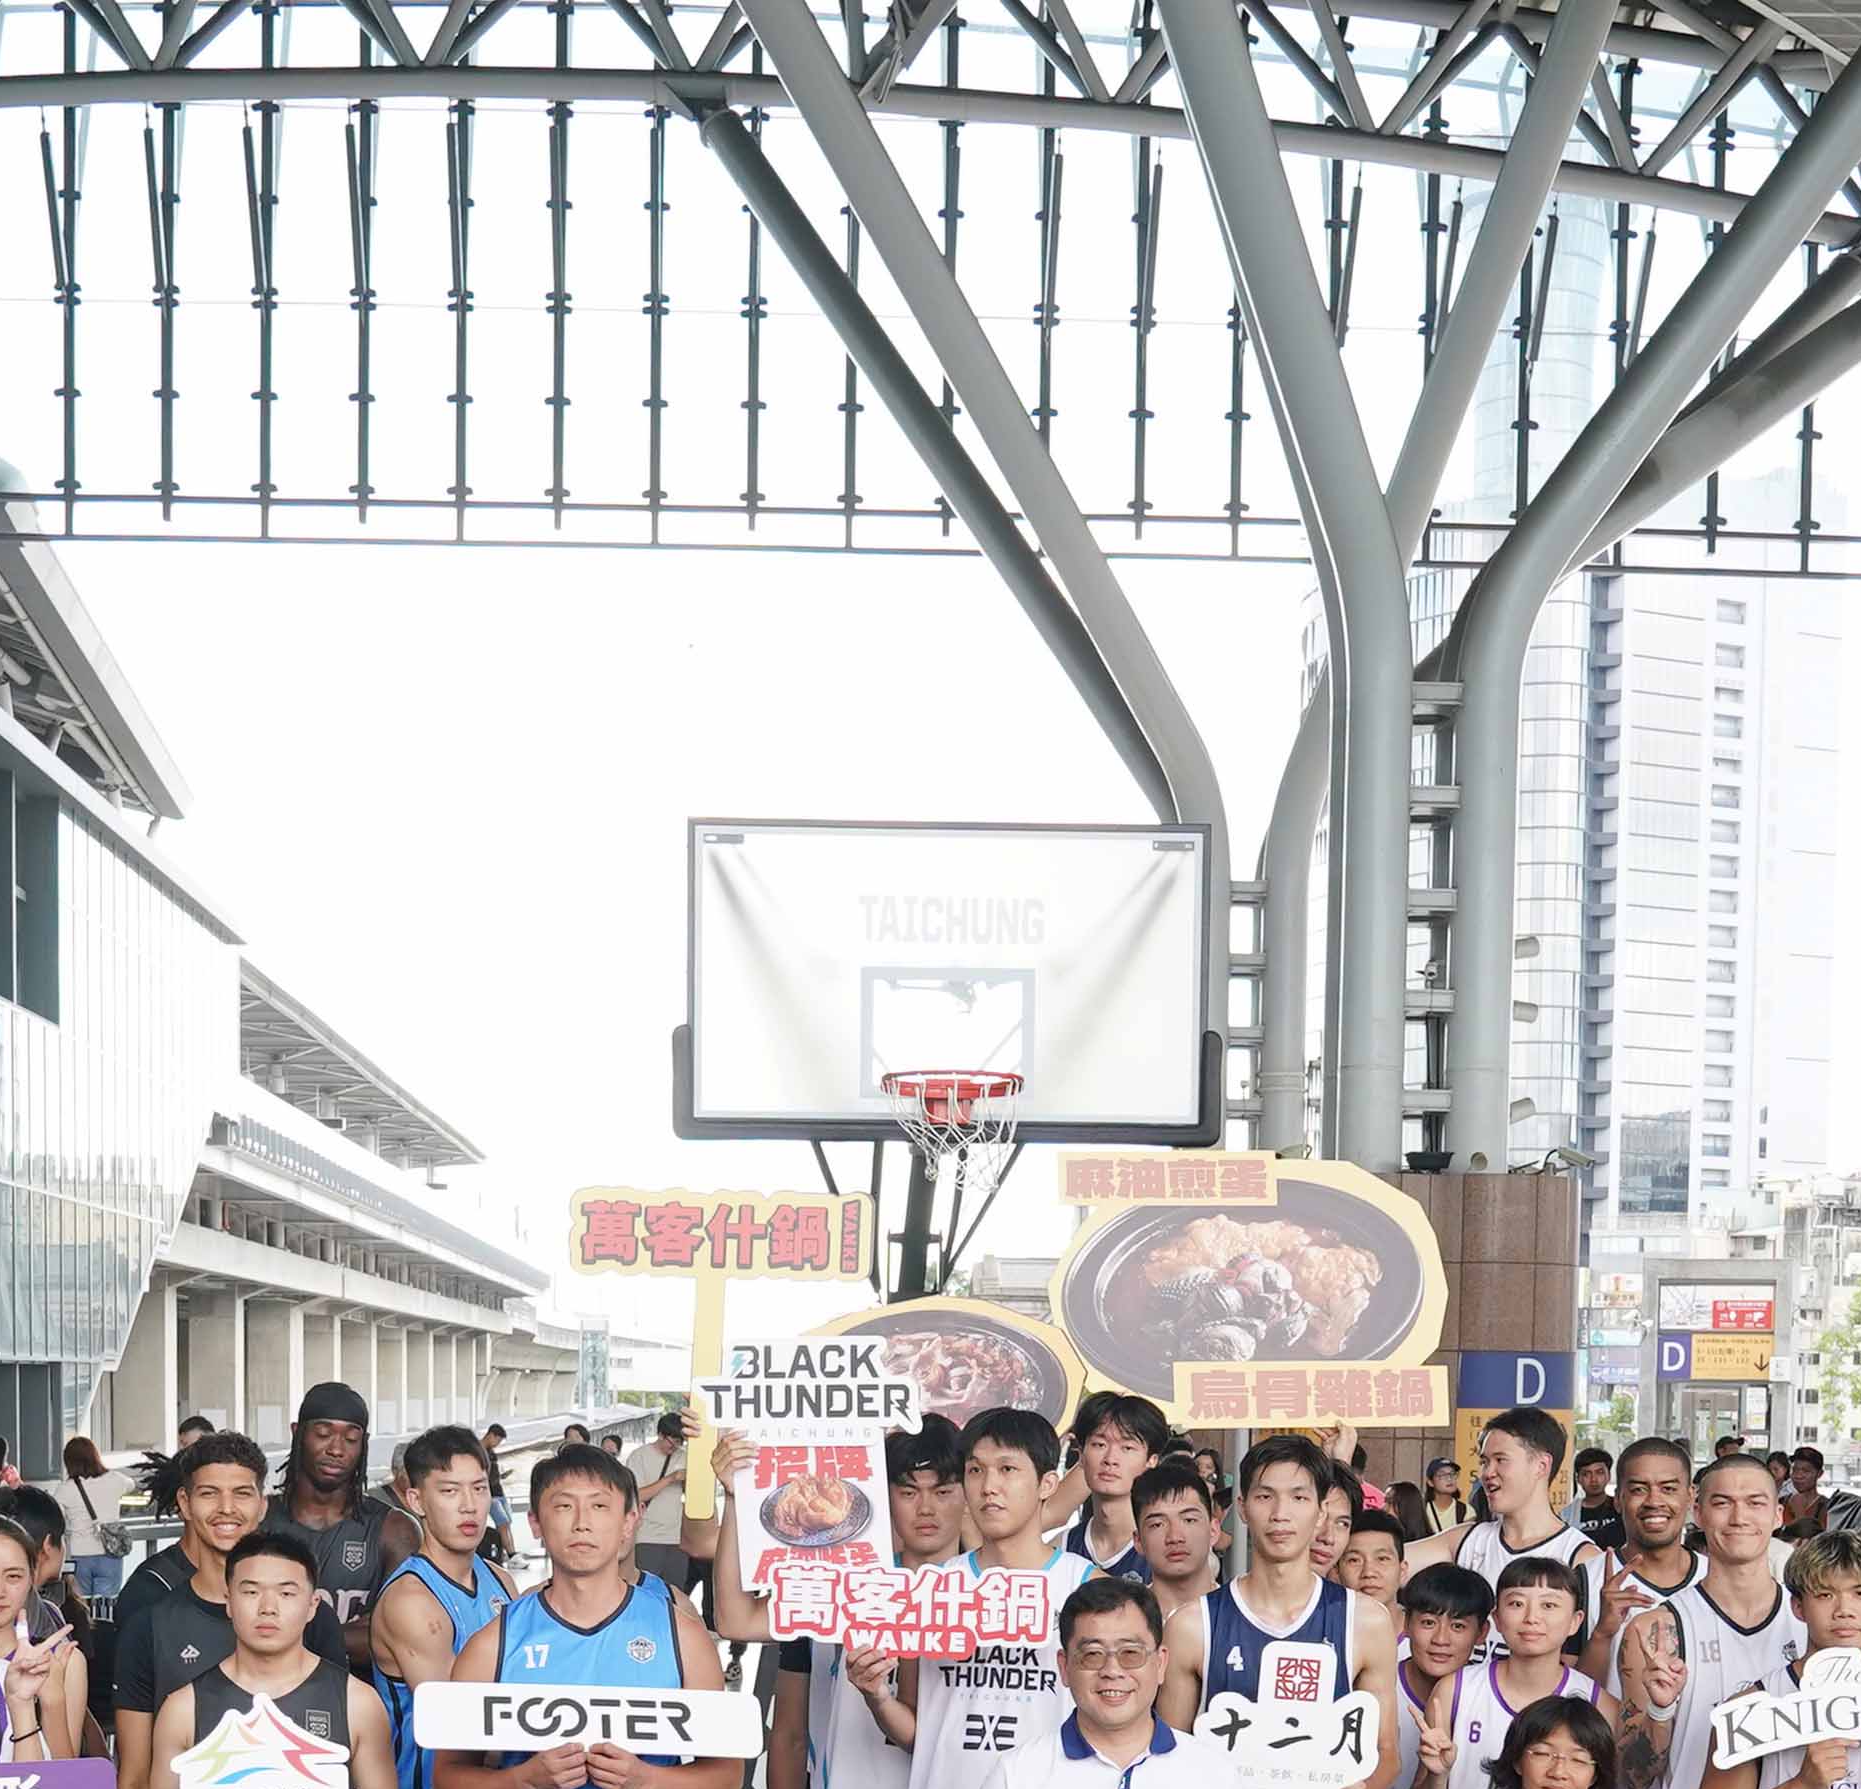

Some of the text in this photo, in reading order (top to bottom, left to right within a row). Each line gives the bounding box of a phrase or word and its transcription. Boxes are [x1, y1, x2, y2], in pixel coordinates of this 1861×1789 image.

[858, 895, 1045, 946] TAICHUNG
[1064, 1159, 1271, 1201] 麻油煎蛋
[579, 1199, 829, 1271] 萬客什鍋
[840, 1202, 857, 1273] WANKE
[731, 1344, 880, 1379] BLACK
[1662, 1341, 1686, 1372] D
[1515, 1357, 1547, 1405] D
[699, 1384, 915, 1424] THUNDER
[776, 1565, 1048, 1640] 萬客什鍋
[523, 1644, 550, 1670] 17
[847, 1628, 967, 1653] WANKE
[1225, 1645, 1245, 1672] 4
[938, 1664, 1058, 1697] THUNDER
[482, 1695, 694, 1743] FOOTER
[1468, 1721, 1481, 1743] 6
